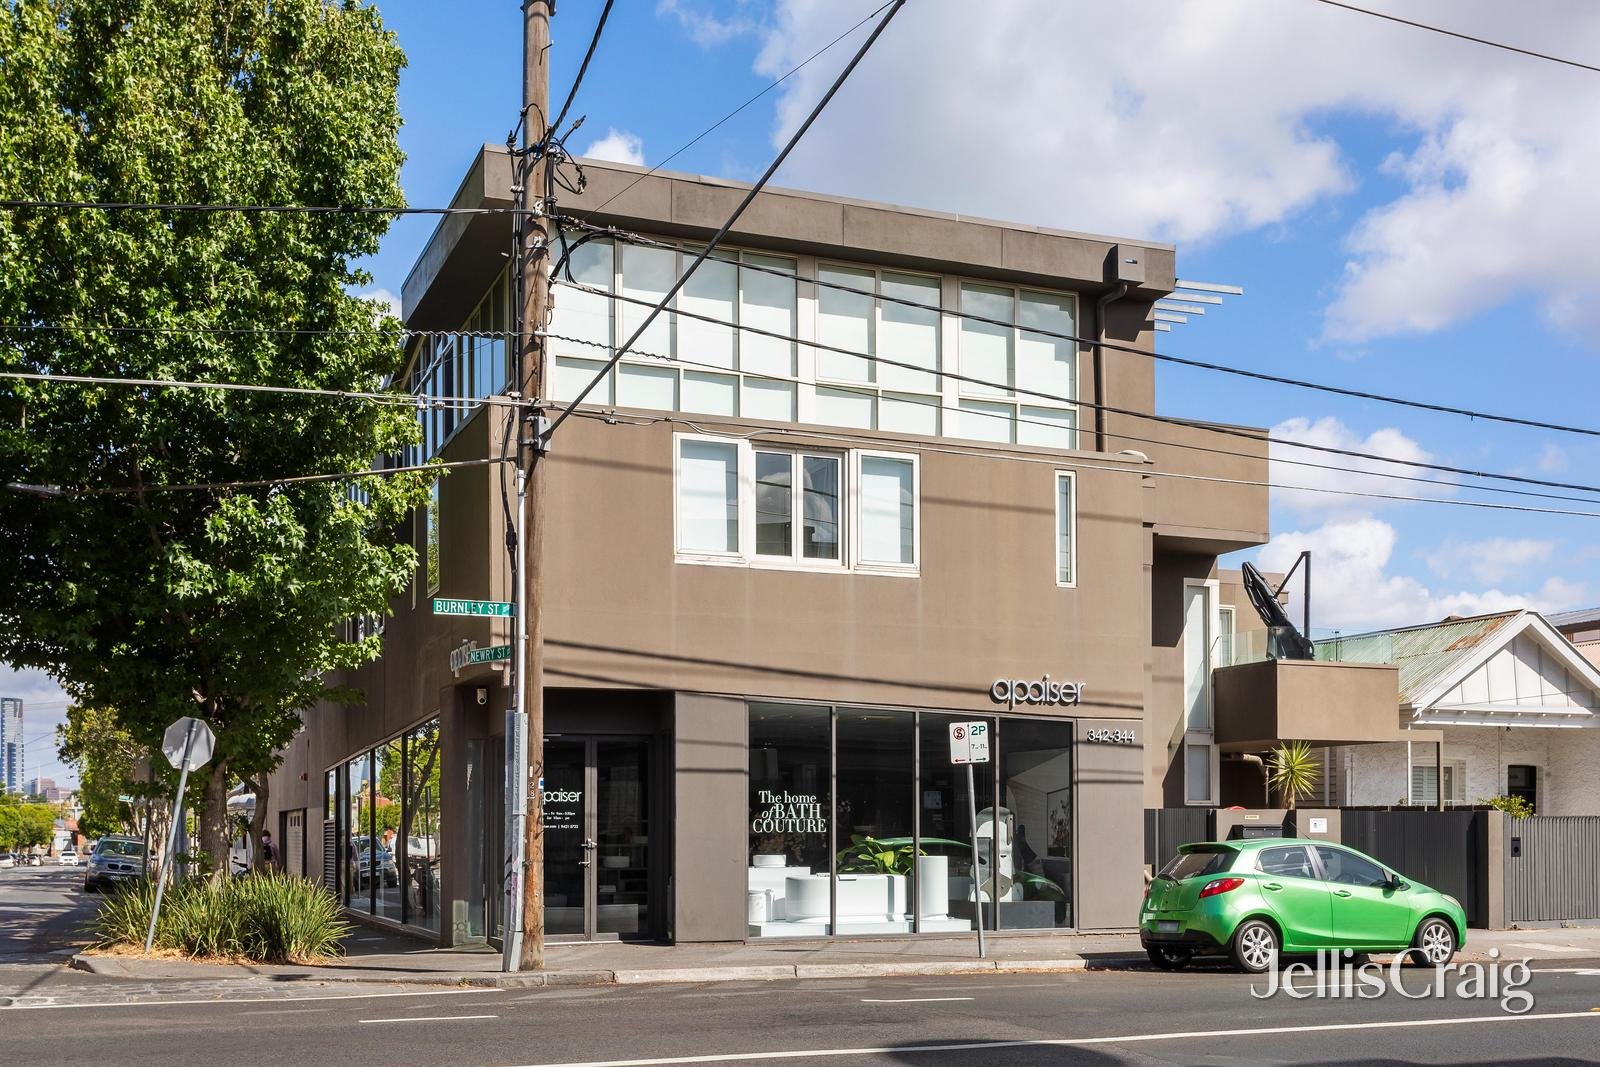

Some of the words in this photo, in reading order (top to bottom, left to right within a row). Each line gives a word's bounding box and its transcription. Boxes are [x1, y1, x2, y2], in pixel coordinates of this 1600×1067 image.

[435, 600, 484, 615] BURNLEY
[487, 603, 500, 615] ST
[470, 648, 495, 662] NEWRY
[497, 646, 506, 659] ST
[991, 673, 1087, 707] apaiser
[970, 725, 986, 736] 2P
[1088, 728, 1136, 742] 342-344
[543, 788, 582, 805] paiser
[758, 790, 782, 804] The
[784, 790, 817, 804] home
[761, 805, 776, 824] of
[774, 803, 822, 819] BATH
[752, 818, 827, 834] COUTURE
